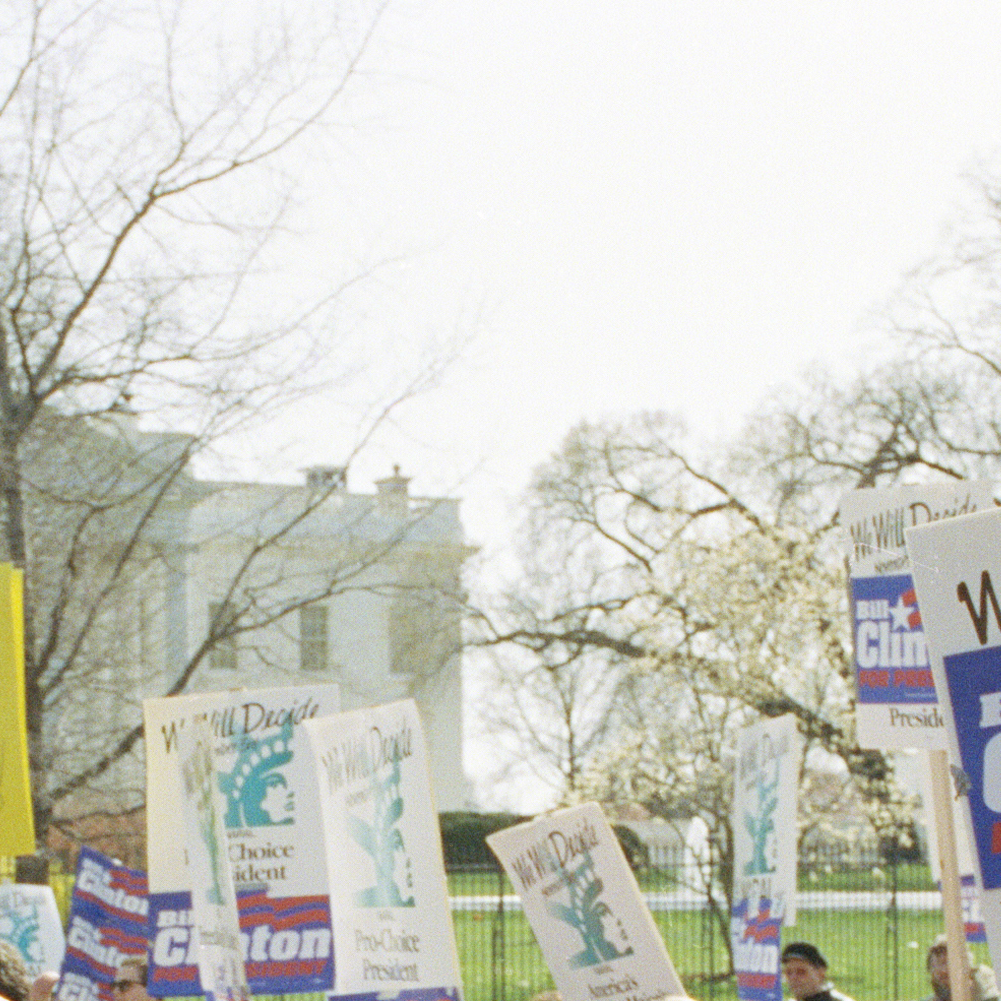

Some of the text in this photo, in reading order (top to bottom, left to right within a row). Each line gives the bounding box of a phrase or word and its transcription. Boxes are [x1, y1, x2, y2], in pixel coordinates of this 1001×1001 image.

[856, 621, 929, 669] Clin
[241, 697, 321, 734] Decide
[354, 927, 421, 953] Pro-Choice
[362, 959, 420, 982] President
